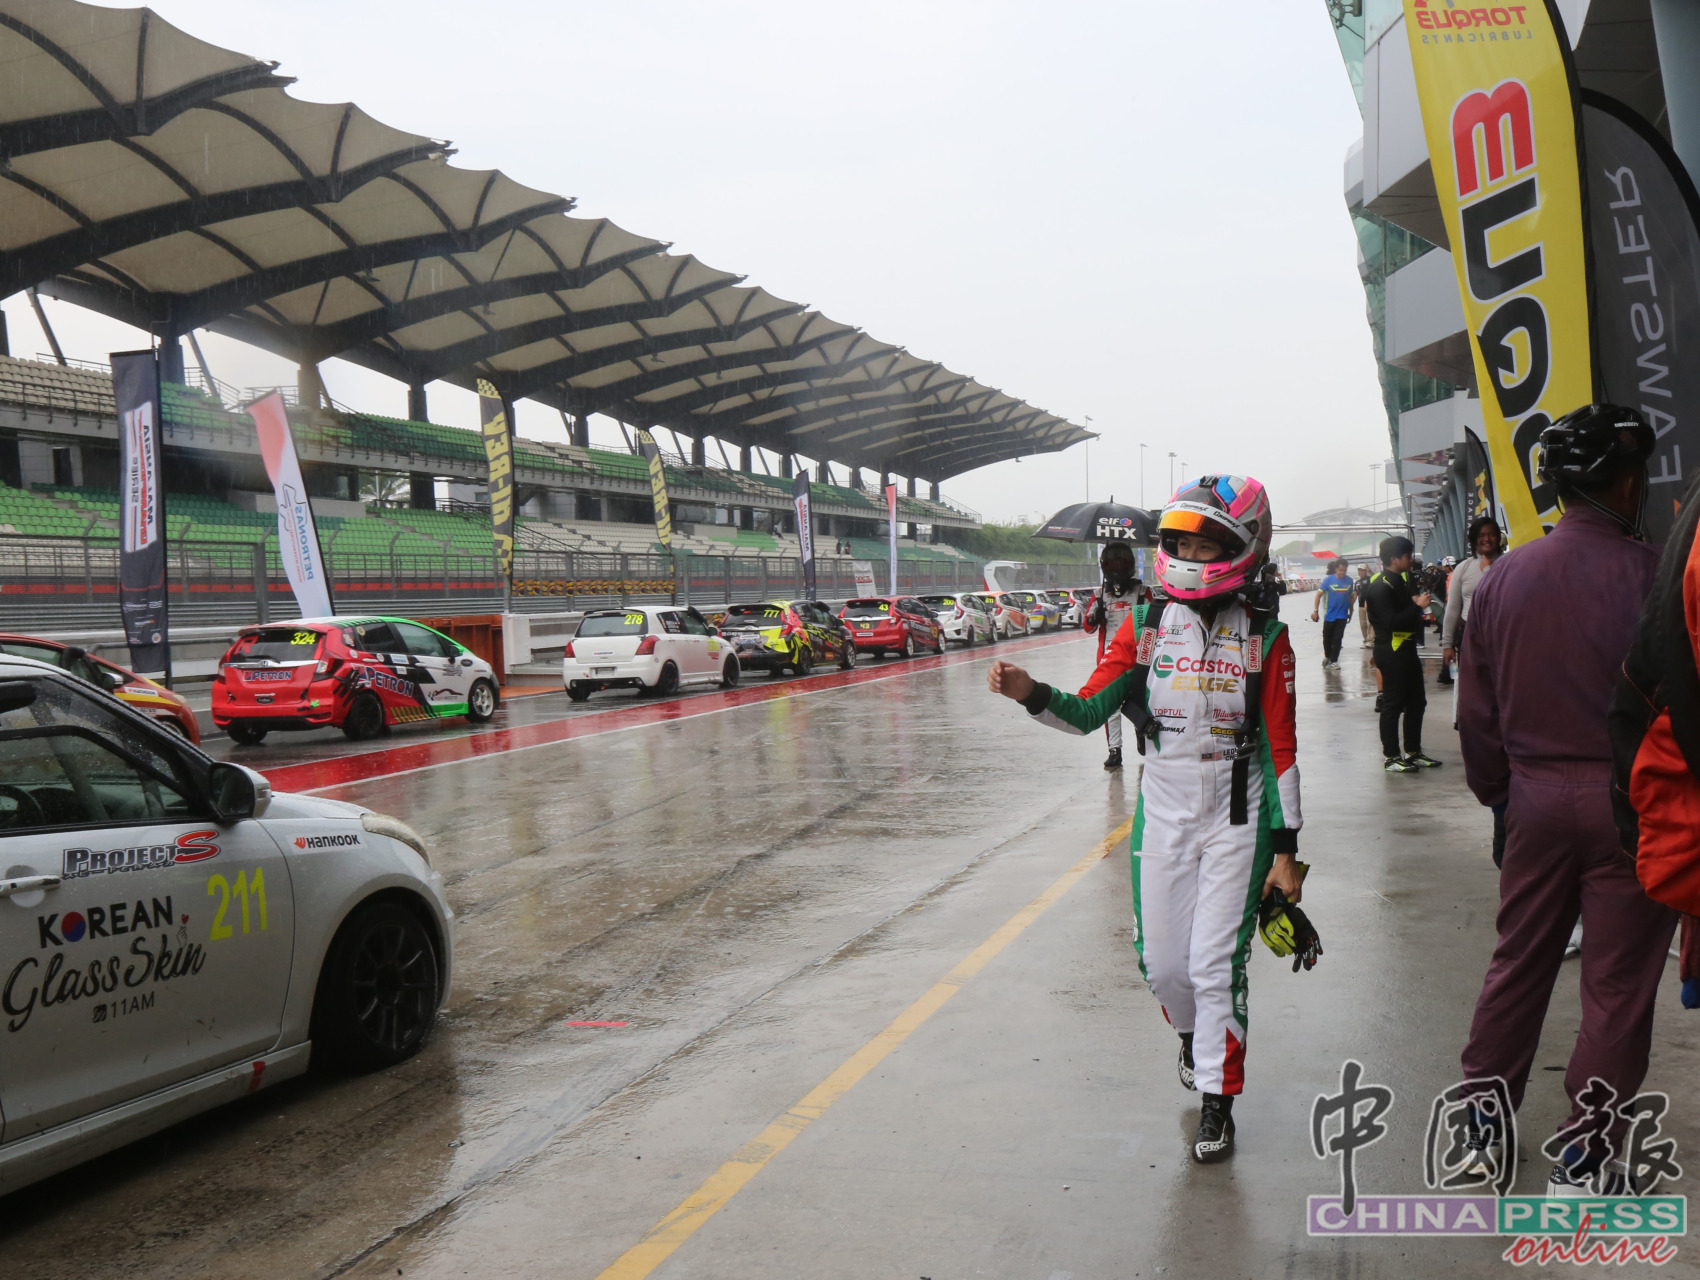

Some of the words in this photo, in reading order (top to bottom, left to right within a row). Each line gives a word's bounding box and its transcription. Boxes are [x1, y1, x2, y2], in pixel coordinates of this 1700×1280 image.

[1098, 517, 1120, 525] elf
[1096, 525, 1137, 540] HTX
[624, 614, 644, 625] 278
[763, 609, 780, 619] 777
[290, 632, 316, 645] 324
[1141, 632, 1153, 662] SIMPSON
[1250, 638, 1258, 669] SIMPSON
[252, 670, 292, 681] PETRON
[367, 666, 414, 698] PETRON
[1171, 676, 1240, 694] EDGE
[1154, 708, 1183, 717] TOPTUL
[1160, 726, 1186, 736] RIPMAX
[306, 834, 360, 848] HANKOOK
[206, 867, 267, 941] 211
[38, 896, 173, 948] KOREAN
[2, 952, 120, 1032] Glass
[124, 933, 206, 988] Skin
[110, 991, 155, 1019] 11AM
